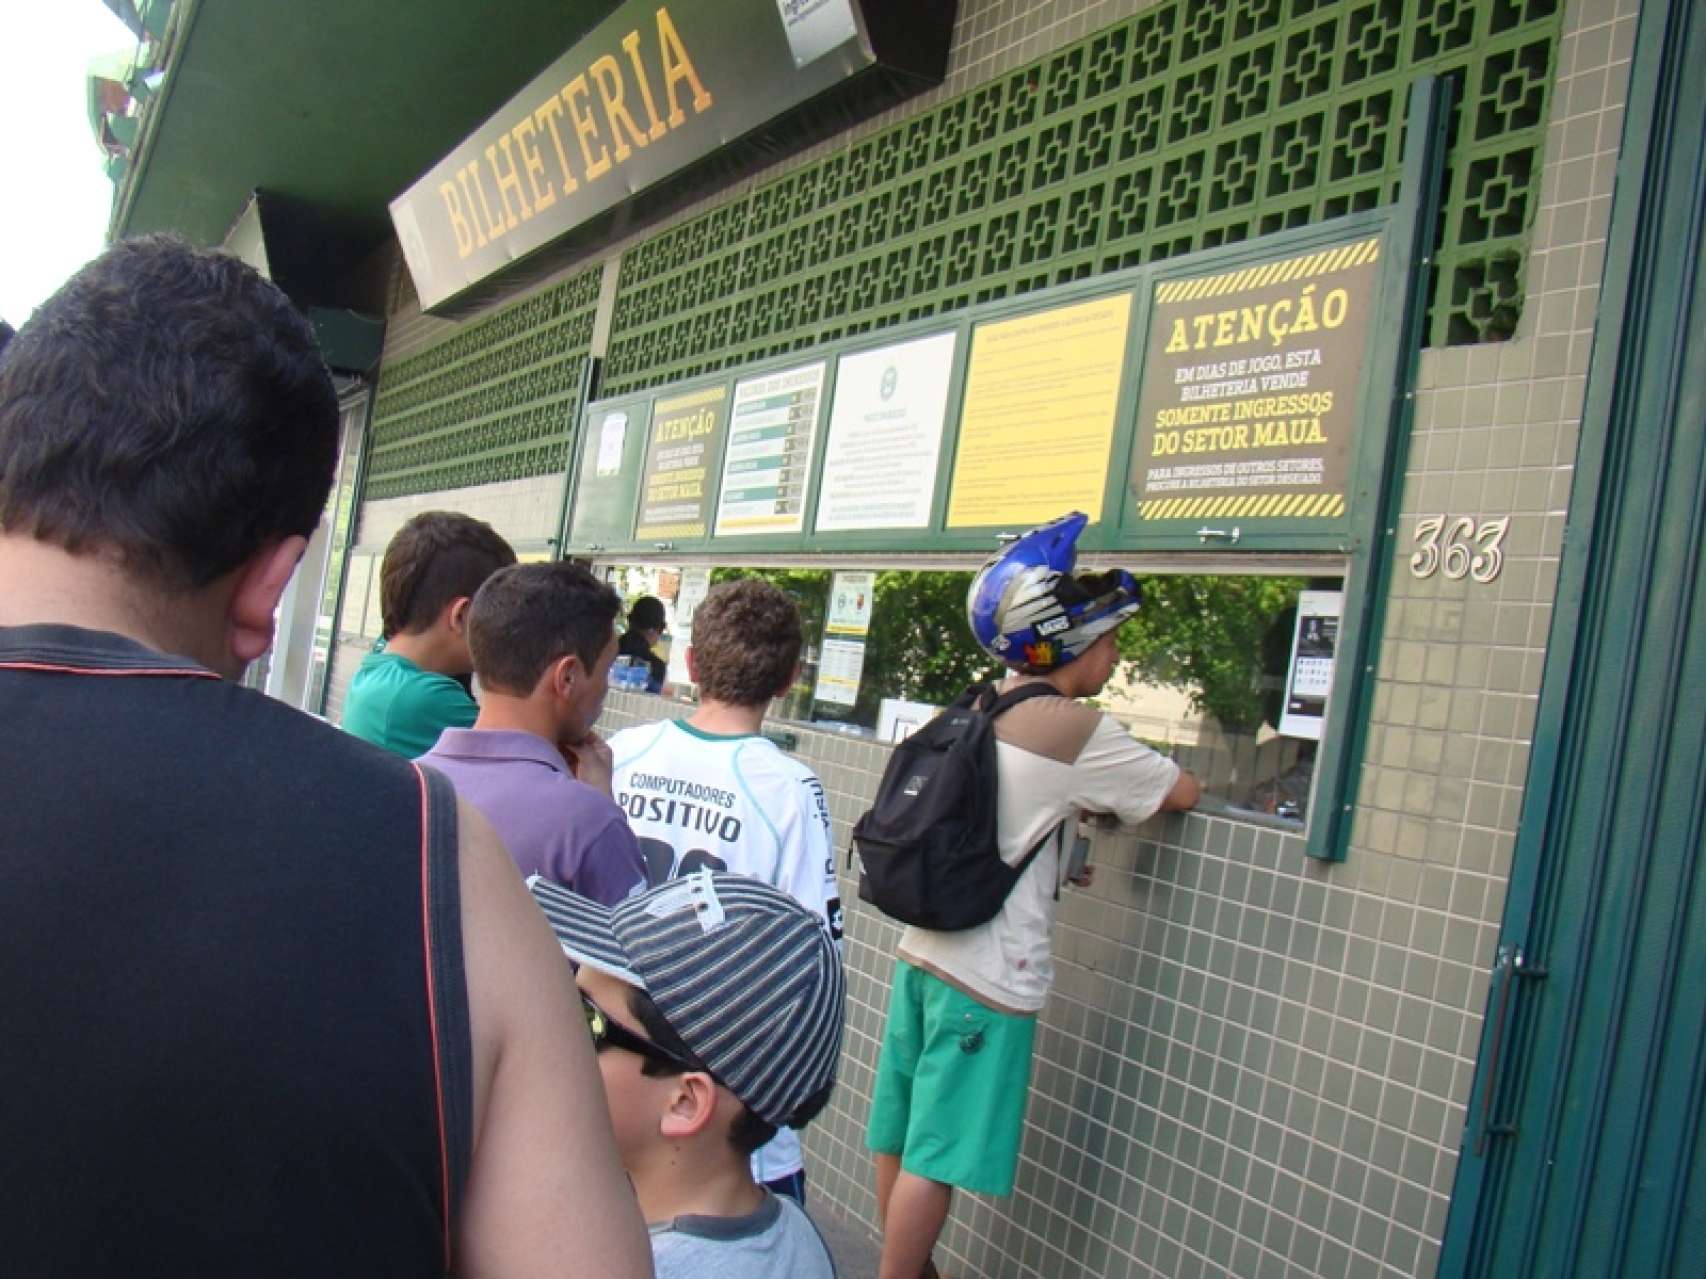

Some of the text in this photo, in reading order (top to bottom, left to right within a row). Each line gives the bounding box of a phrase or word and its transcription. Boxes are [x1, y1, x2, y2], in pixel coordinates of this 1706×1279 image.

[440, 6, 713, 259] BILHETERIA
[1165, 283, 1349, 353] ATENÇÃO
[1175, 367, 1195, 384] EM
[1196, 361, 1227, 381] DIAS
[1228, 359, 1247, 376] DE
[1285, 349, 1321, 368] ESTA
[1180, 371, 1309, 401] BILHETERIA VENDE
[1155, 391, 1334, 428] SOMENTE INGRESSOS
[1152, 430, 1181, 456] DO
[1182, 423, 1249, 453] SETOR
[1409, 513, 1512, 583] 363
[630, 771, 737, 808] COMPUTADORES
